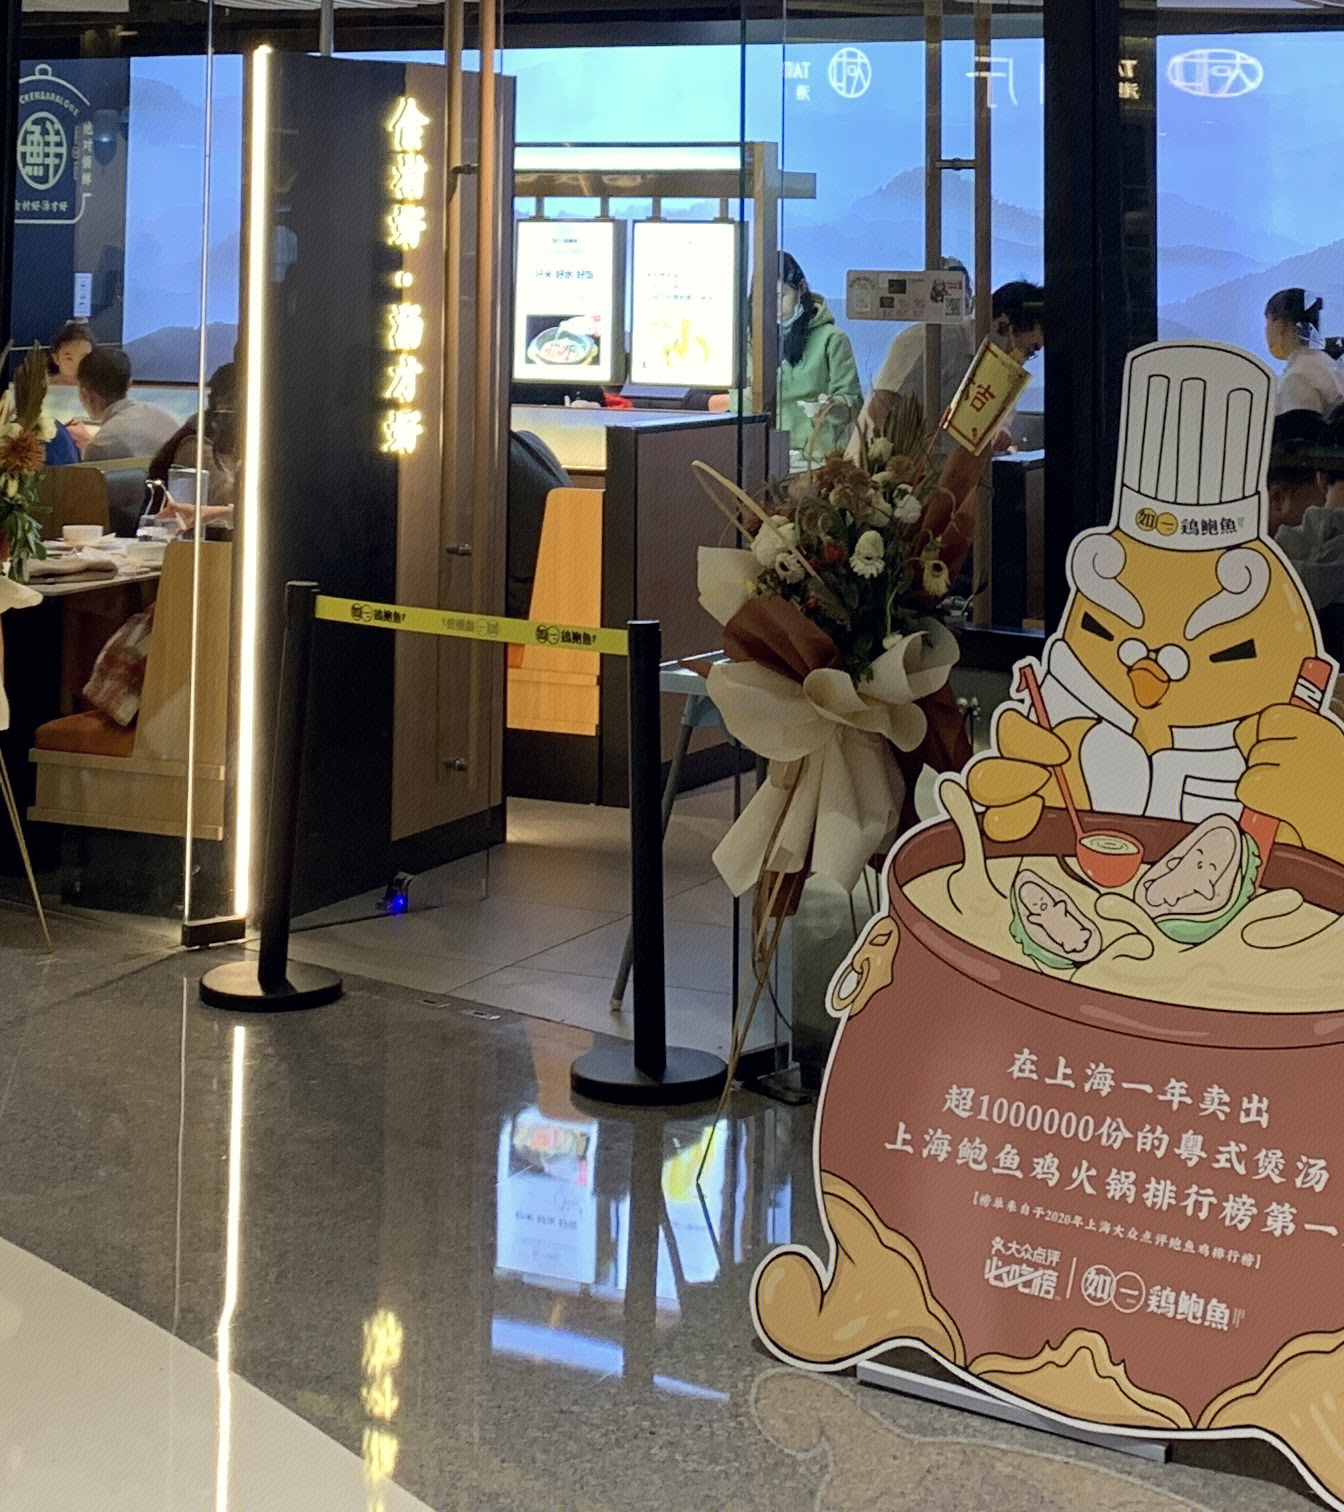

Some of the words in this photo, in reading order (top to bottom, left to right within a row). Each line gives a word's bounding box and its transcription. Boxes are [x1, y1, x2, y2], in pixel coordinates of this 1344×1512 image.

[1007, 1048, 1269, 1128] 在上海一年卖出
[942, 1084, 1329, 1192] 超1000000份的粤式煲汤
[1006, 1240, 1061, 1267] 大众点评
